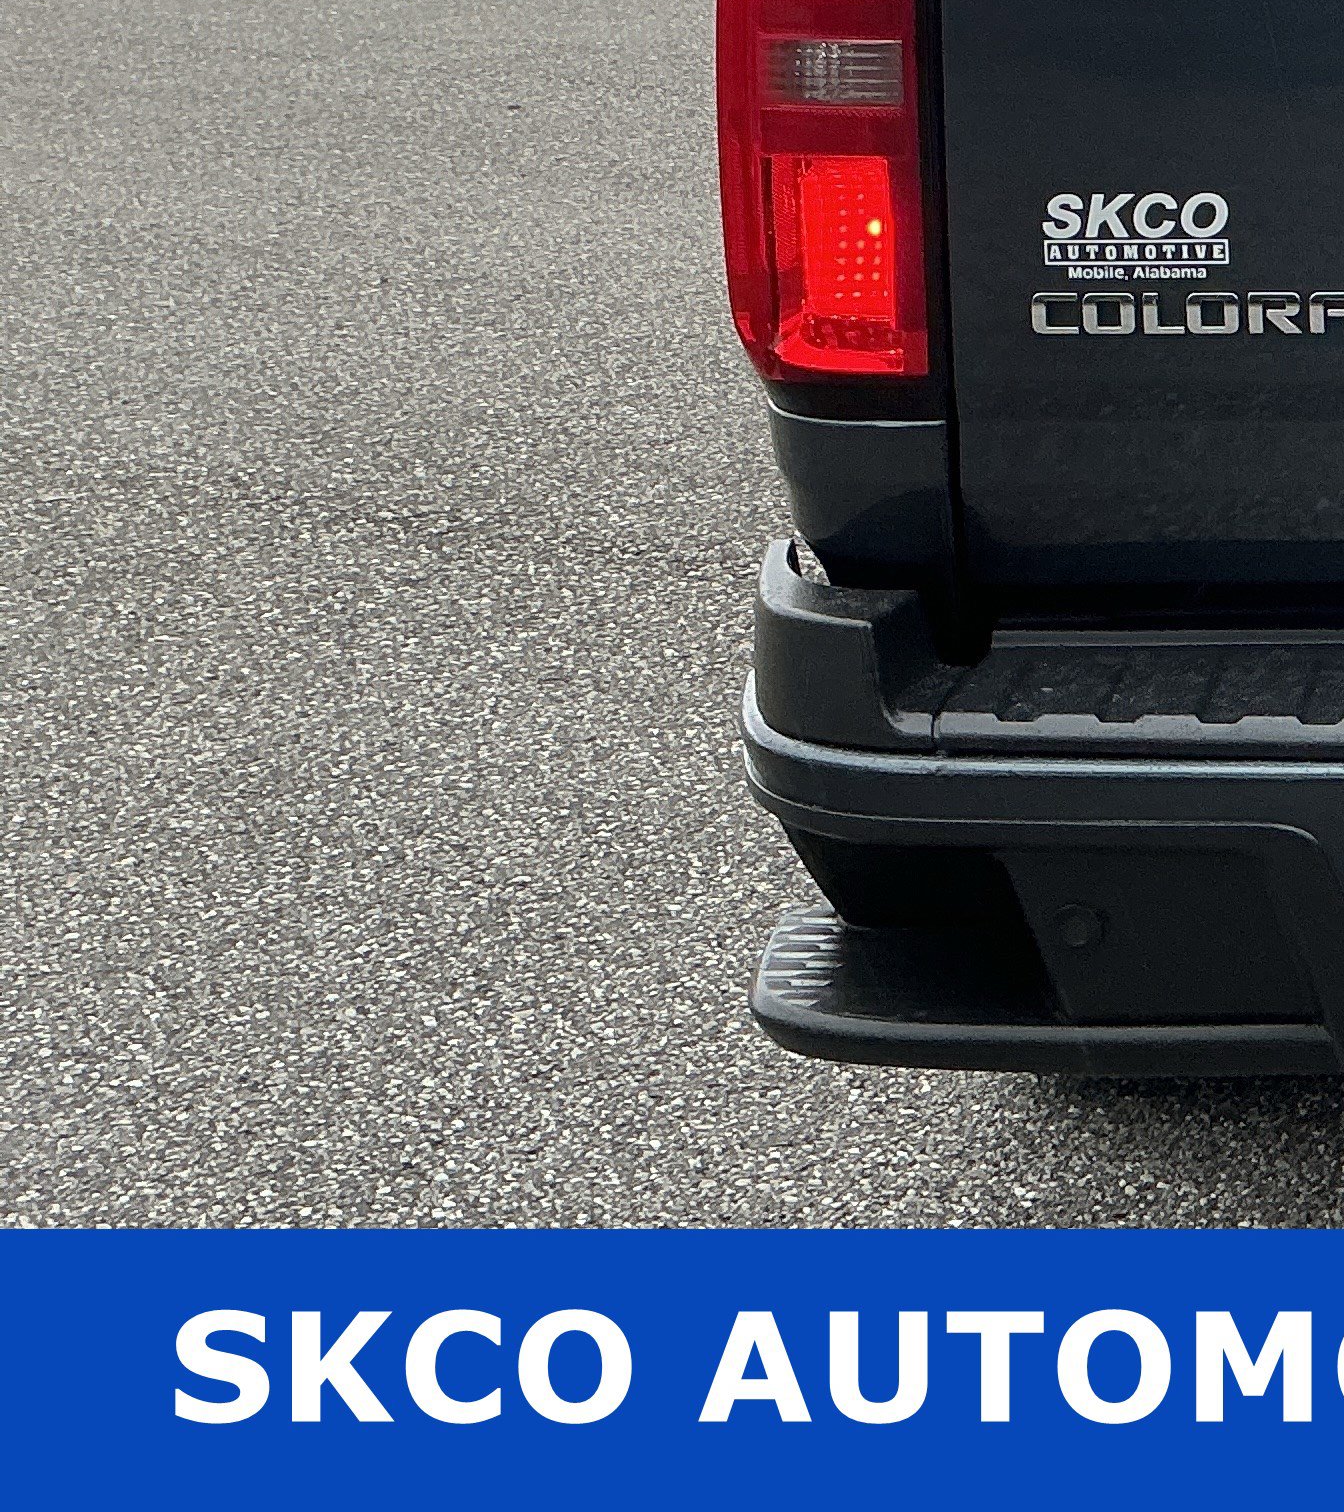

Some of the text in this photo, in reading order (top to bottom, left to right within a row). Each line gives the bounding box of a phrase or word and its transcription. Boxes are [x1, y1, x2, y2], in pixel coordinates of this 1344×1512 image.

[1042, 193, 1229, 239] SKCO
[1049, 244, 1225, 261] AUTOMOTIVE
[1067, 265, 1207, 281] Mobile, Alabama
